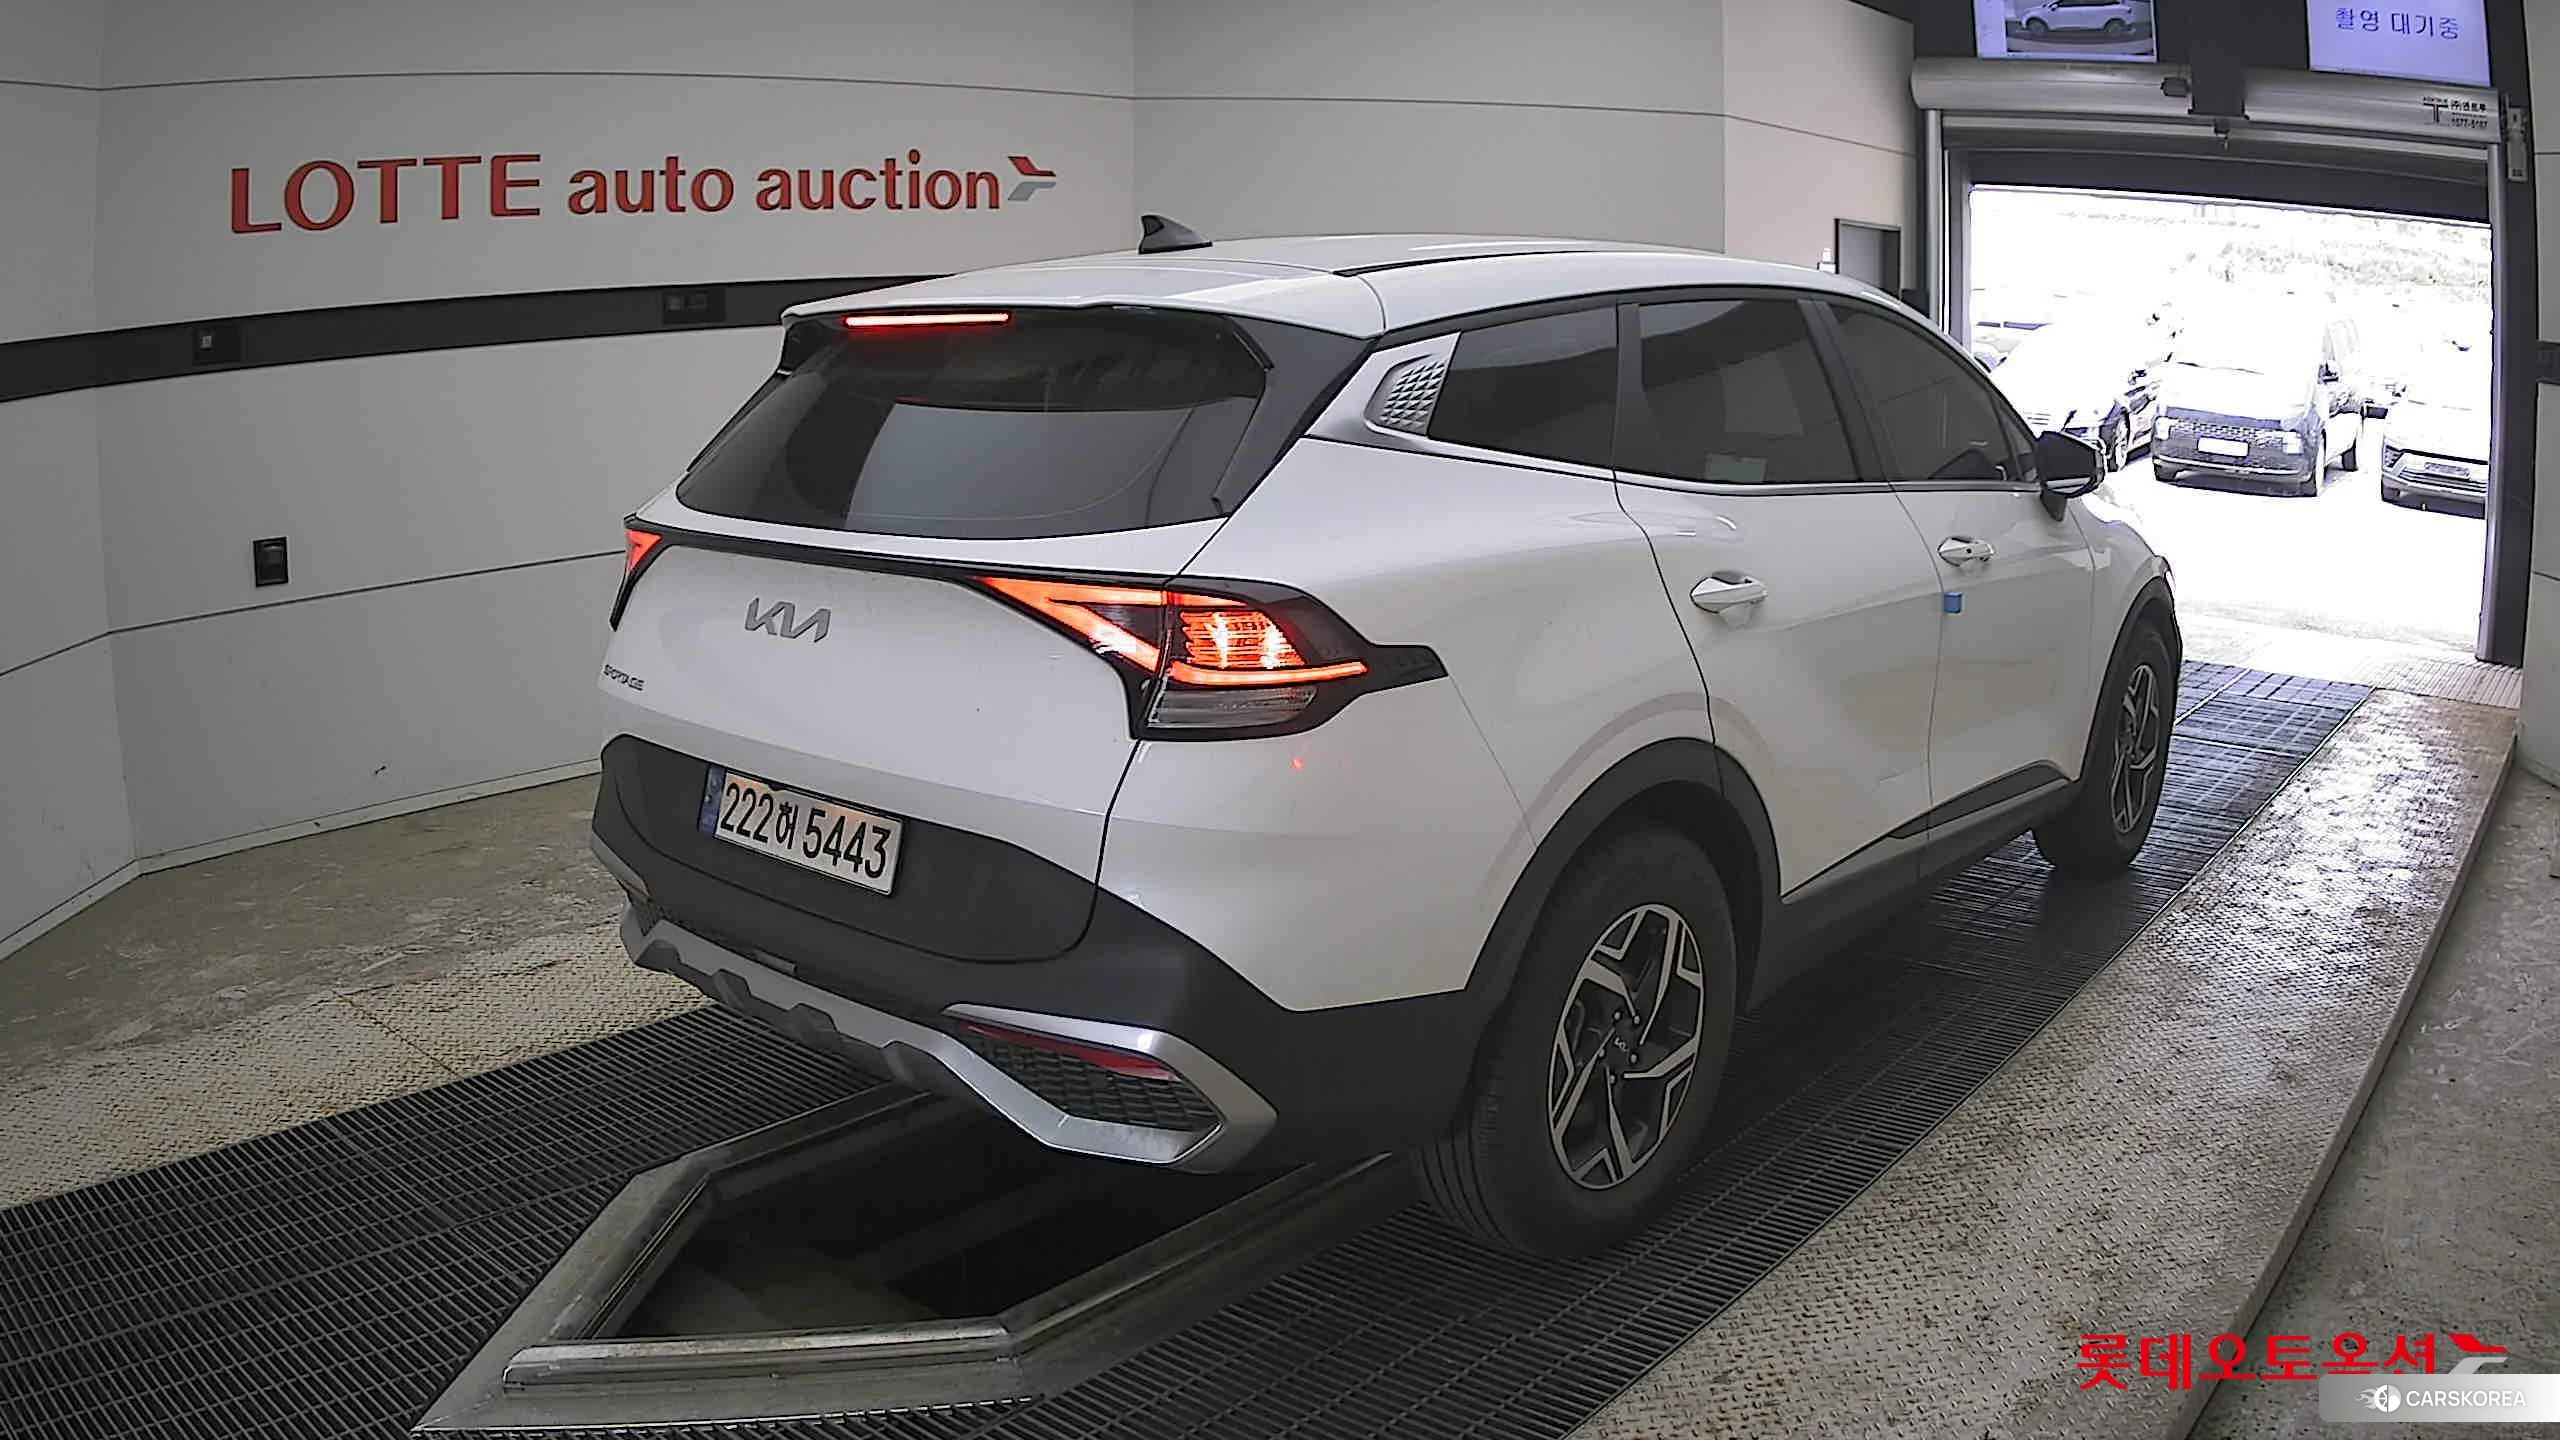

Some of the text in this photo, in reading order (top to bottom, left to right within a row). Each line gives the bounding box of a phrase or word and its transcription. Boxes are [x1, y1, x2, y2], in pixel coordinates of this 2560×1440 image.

[2336, 7, 2459, 40] 촬영 대기중
[230, 150, 1000, 234] LOTTE auto auction
[745, 597, 831, 643] KIA
[802, 807, 891, 879] 5443
